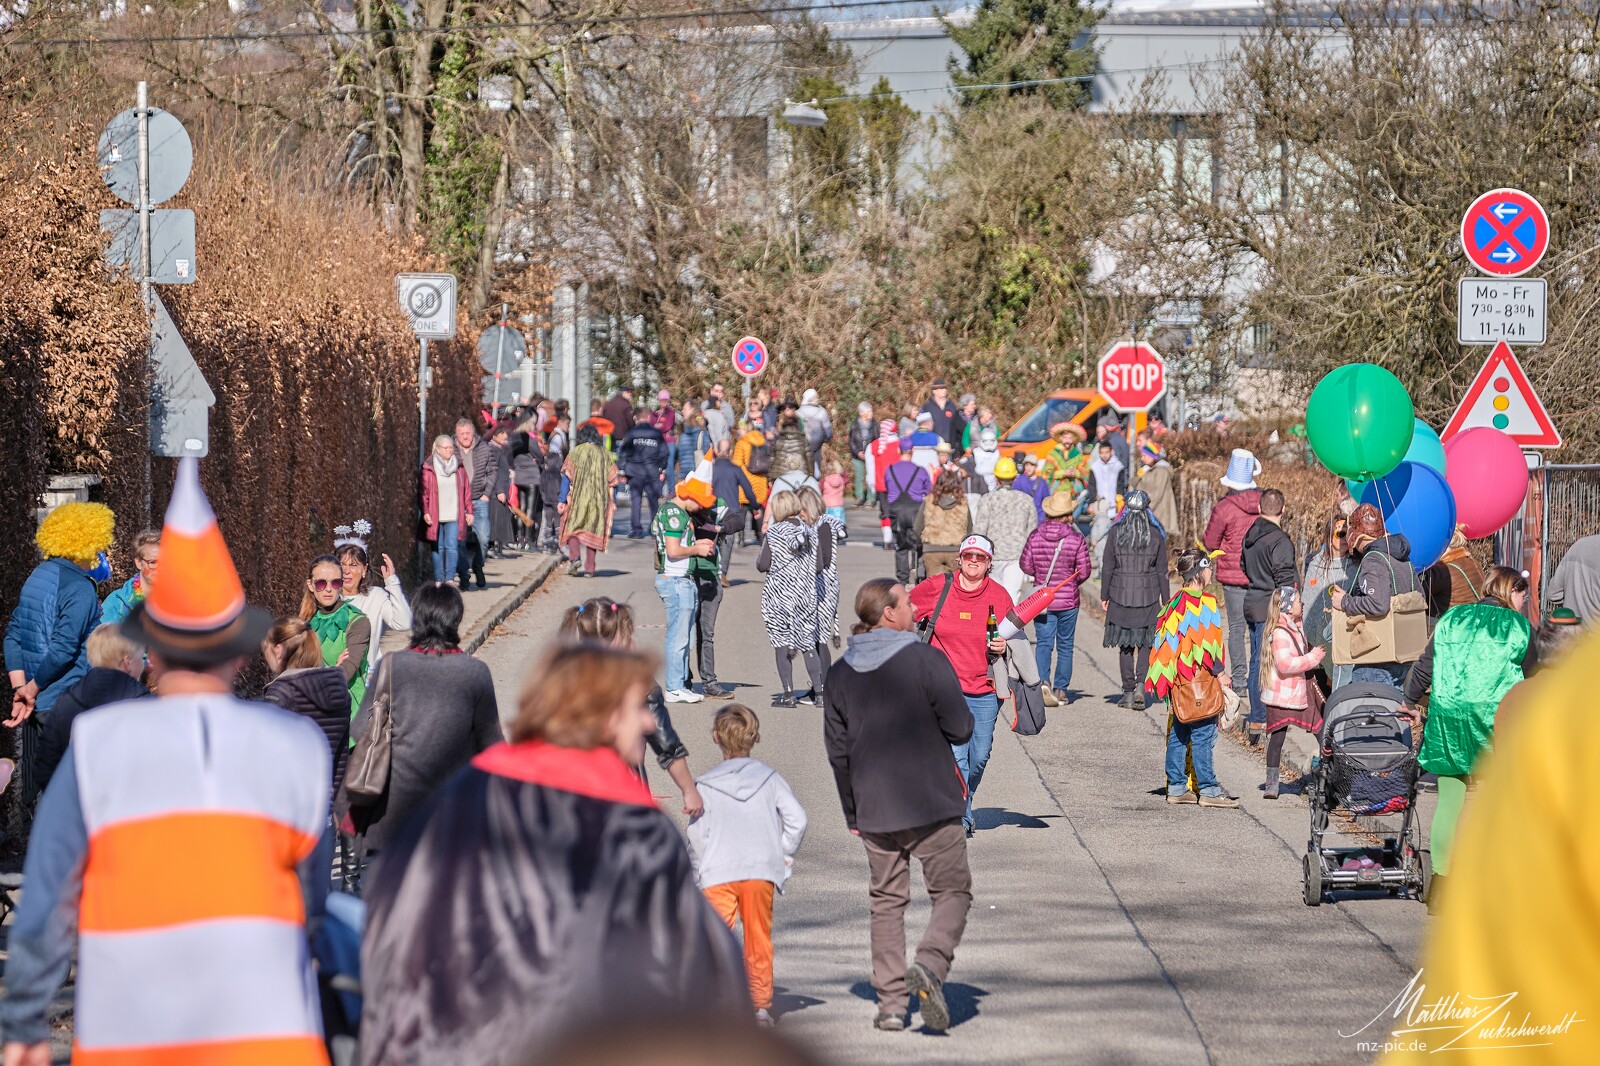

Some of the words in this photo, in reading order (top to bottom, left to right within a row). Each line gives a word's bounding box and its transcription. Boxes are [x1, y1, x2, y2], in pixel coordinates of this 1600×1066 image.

[1476, 286, 1498, 299] Mo
[1513, 286, 1530, 299] Fr
[415, 292, 435, 309] 30
[413, 320, 438, 330] ONE
[1105, 363, 1160, 392] STOP
